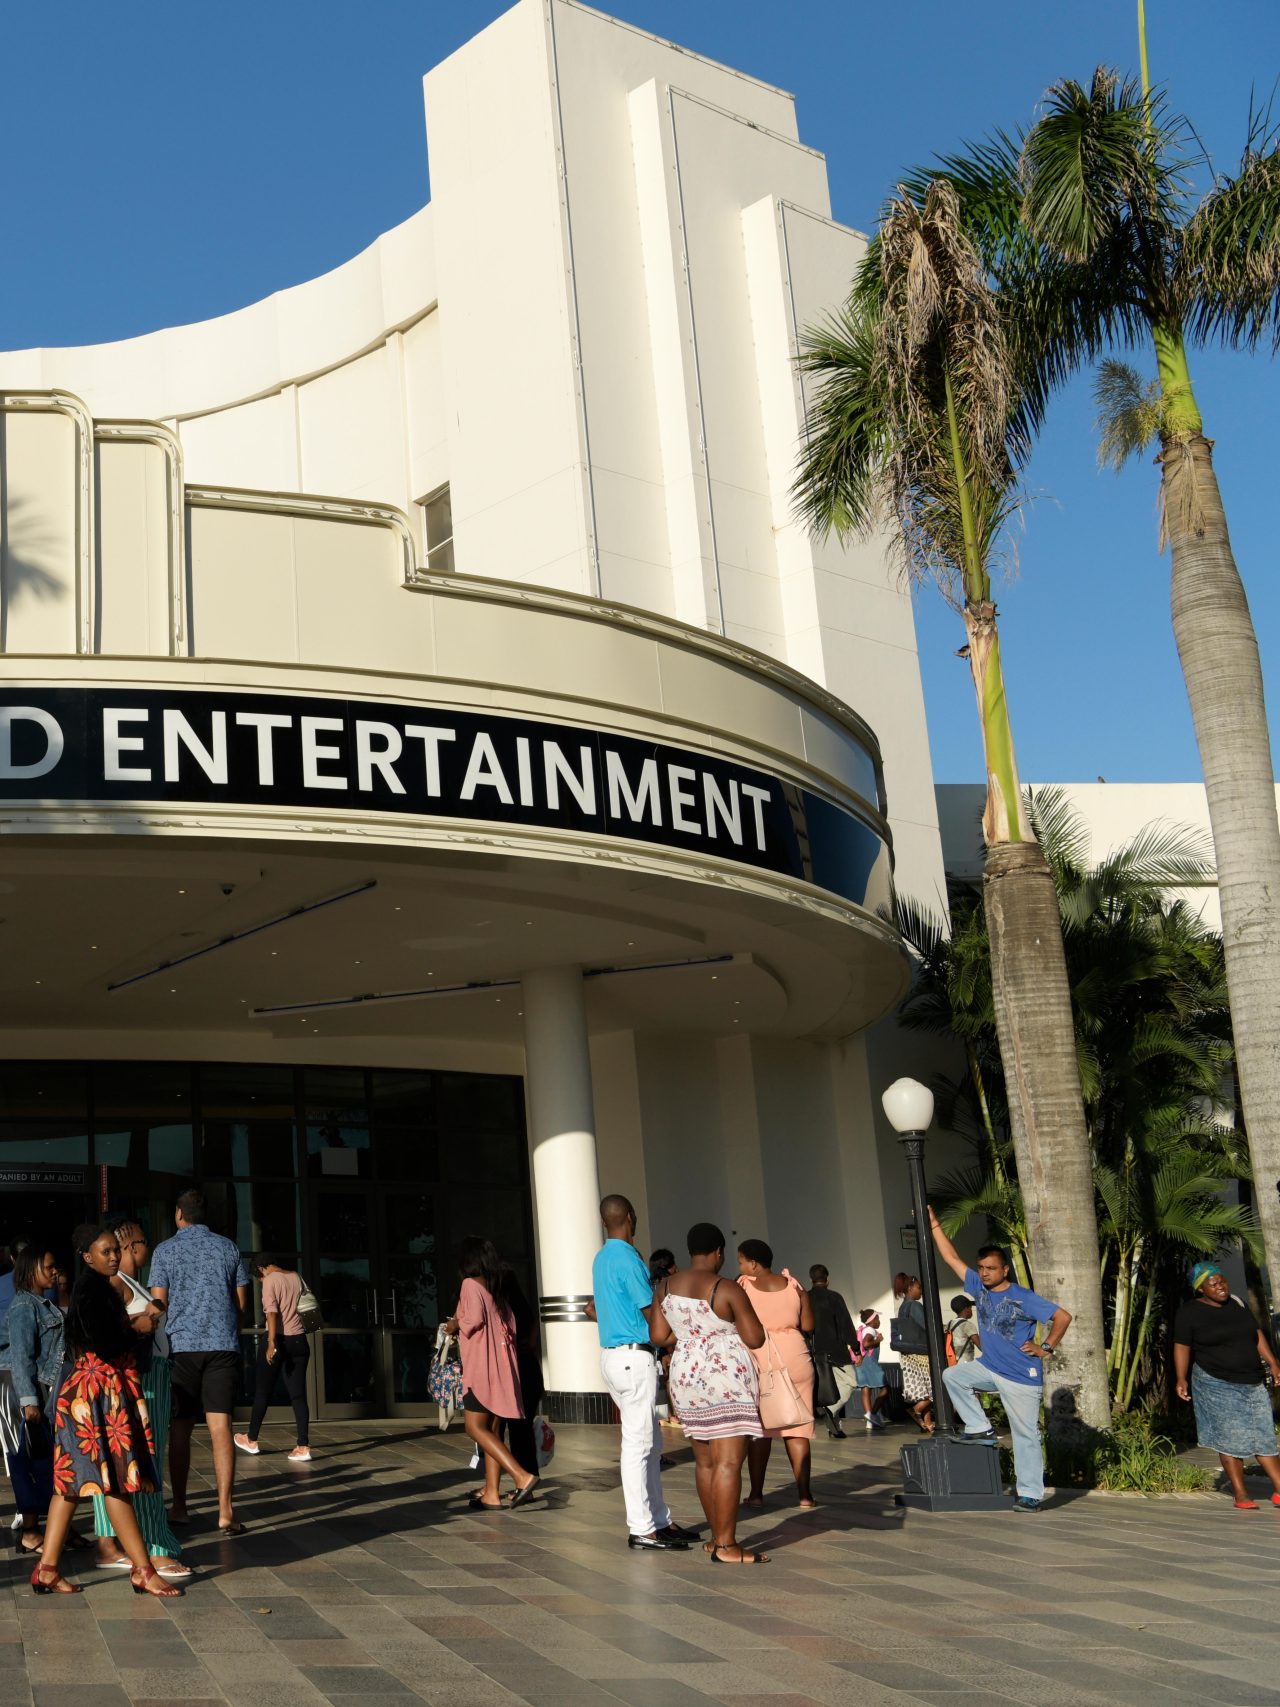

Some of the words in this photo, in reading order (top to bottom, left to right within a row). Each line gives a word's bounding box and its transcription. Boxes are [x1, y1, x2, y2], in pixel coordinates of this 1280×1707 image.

[102, 706, 772, 852] ENTERTAINMENT
[30, 1173, 41, 1182] BY
[43, 1174, 55, 1182] AN
[57, 1174, 82, 1183] ADULT
